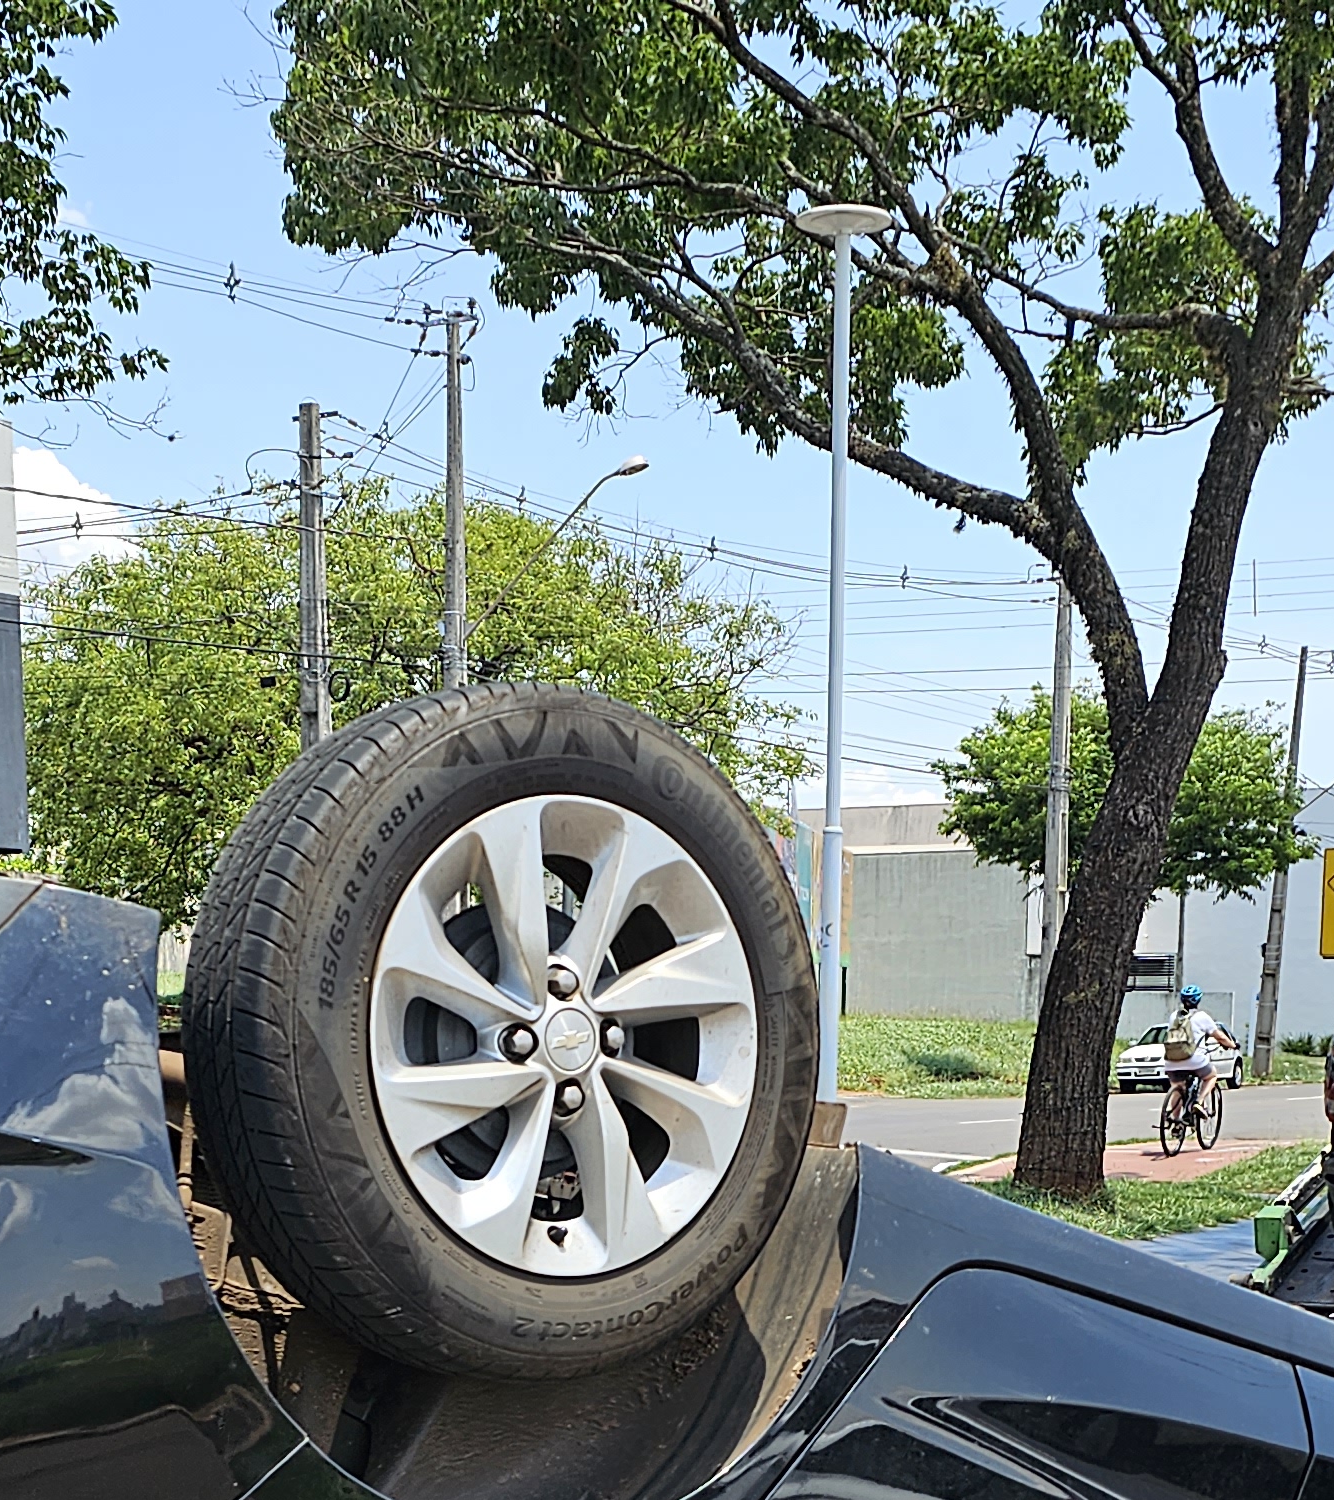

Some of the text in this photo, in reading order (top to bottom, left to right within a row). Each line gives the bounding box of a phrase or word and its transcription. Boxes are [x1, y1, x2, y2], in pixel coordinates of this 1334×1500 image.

[318, 904, 351, 1010] 185/65
[343, 880, 362, 903] R
[355, 845, 377, 877] 15
[378, 806, 406, 842] 88
[405, 786, 425, 811] H
[510, 1315, 536, 1338] 2
[539, 1222, 749, 1341] PowerContact
